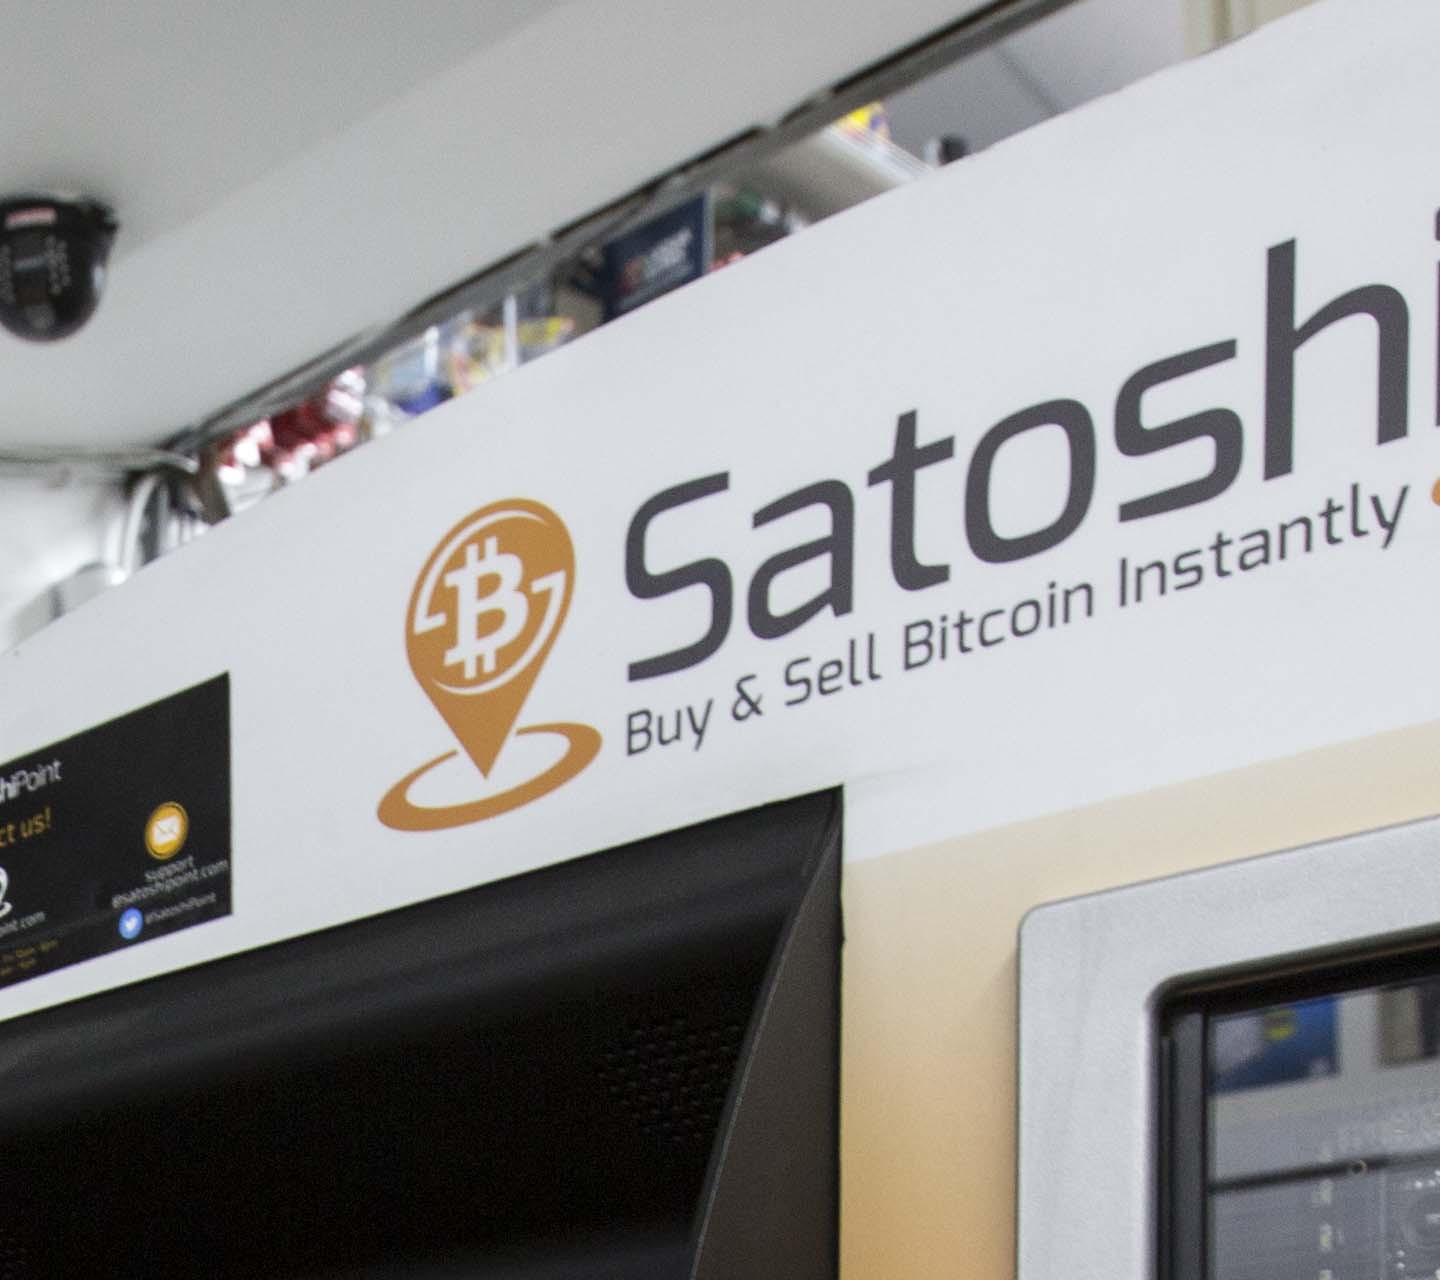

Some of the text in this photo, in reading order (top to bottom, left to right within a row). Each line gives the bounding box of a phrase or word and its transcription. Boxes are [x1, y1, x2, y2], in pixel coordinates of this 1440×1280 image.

[627, 483, 1409, 756] Buy & Sell Bitcoin Instantly
[20, 806, 51, 838] us!
